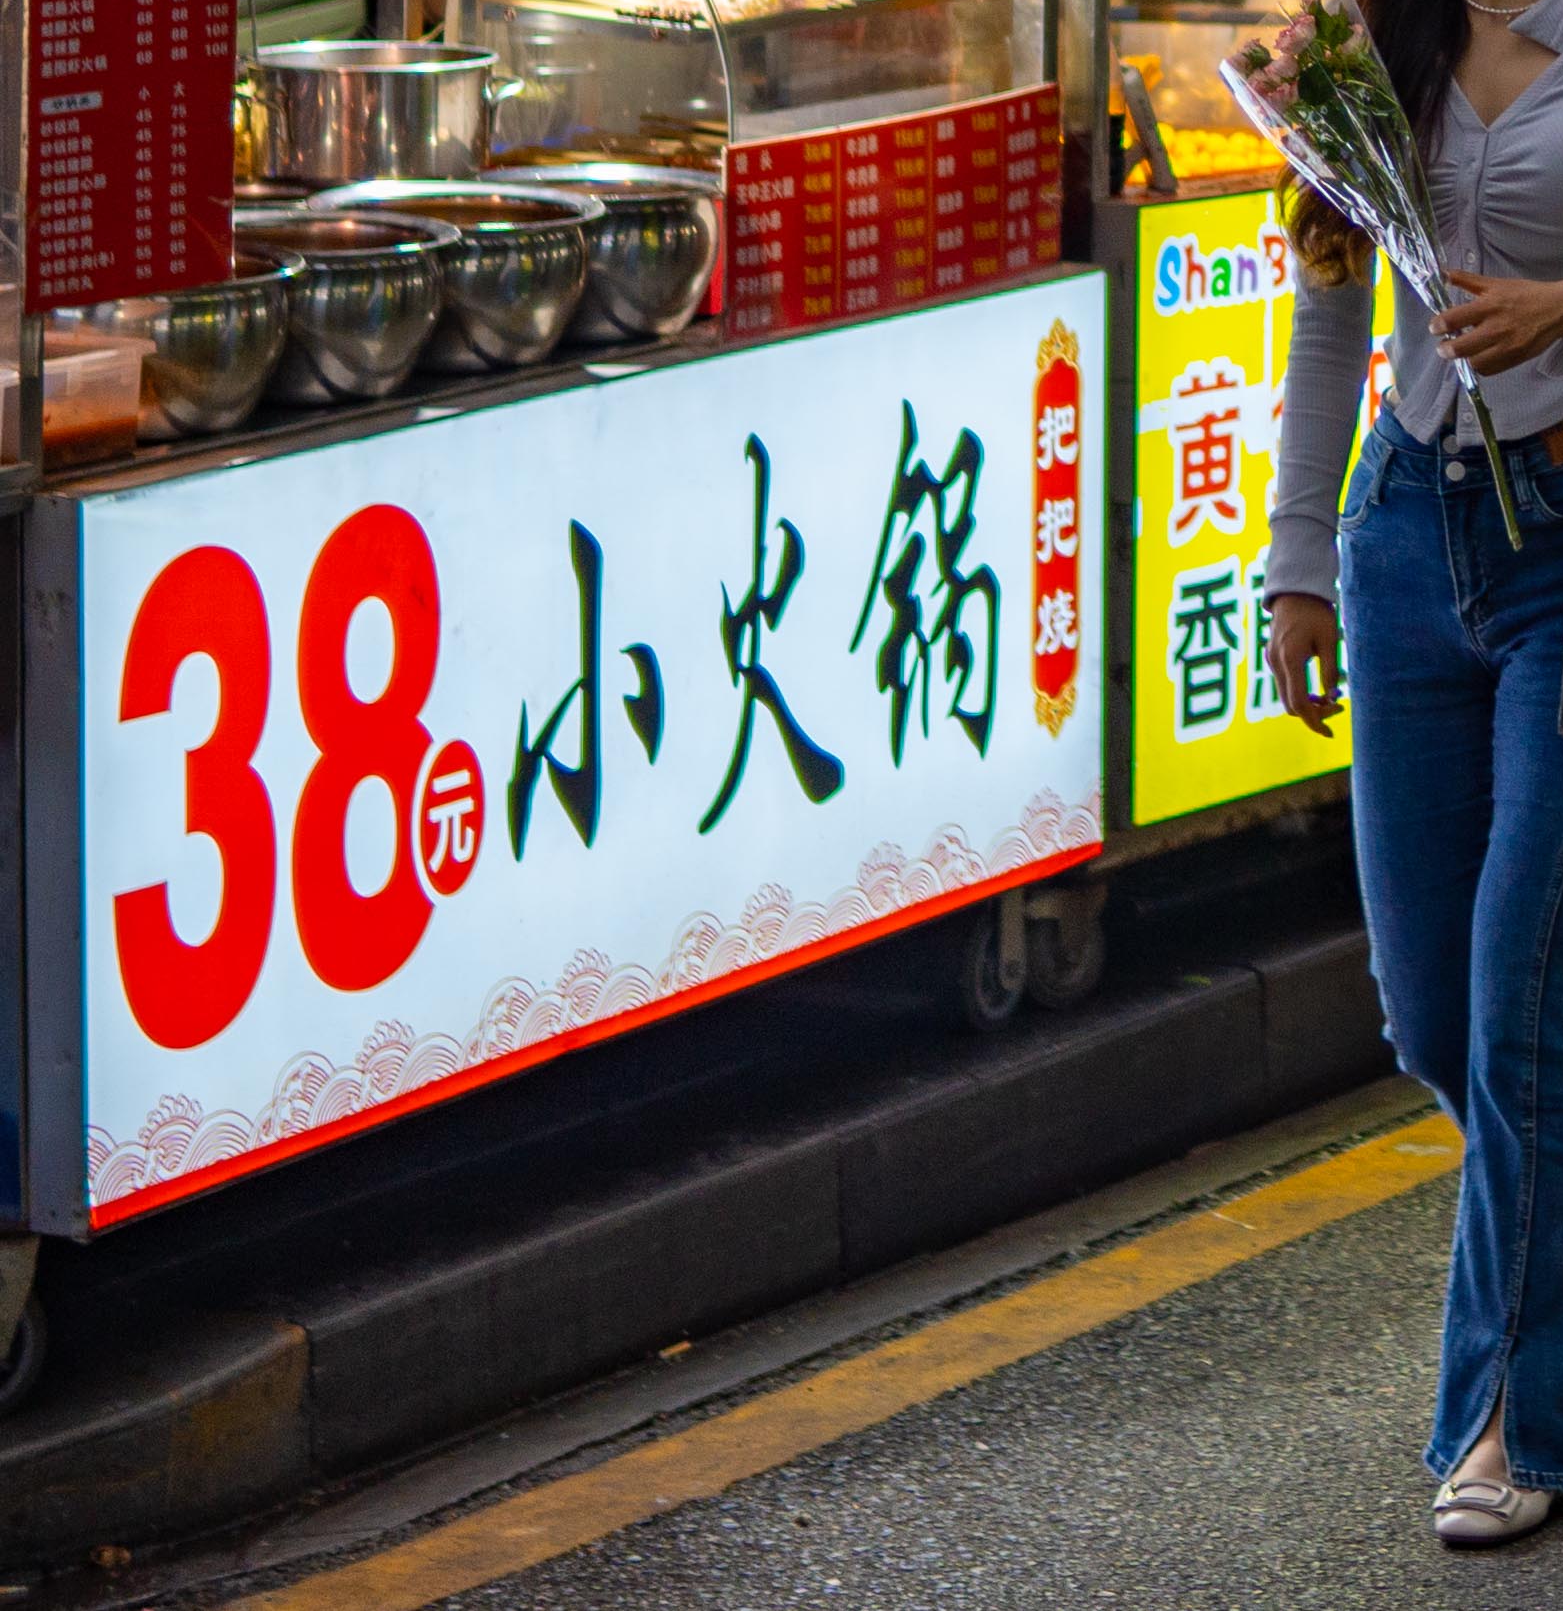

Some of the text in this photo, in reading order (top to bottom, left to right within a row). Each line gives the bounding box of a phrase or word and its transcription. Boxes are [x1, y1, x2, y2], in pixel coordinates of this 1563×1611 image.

[113, 398, 1001, 1051] 38 元 小火锅
[1037, 404, 1079, 657] 把把烧
